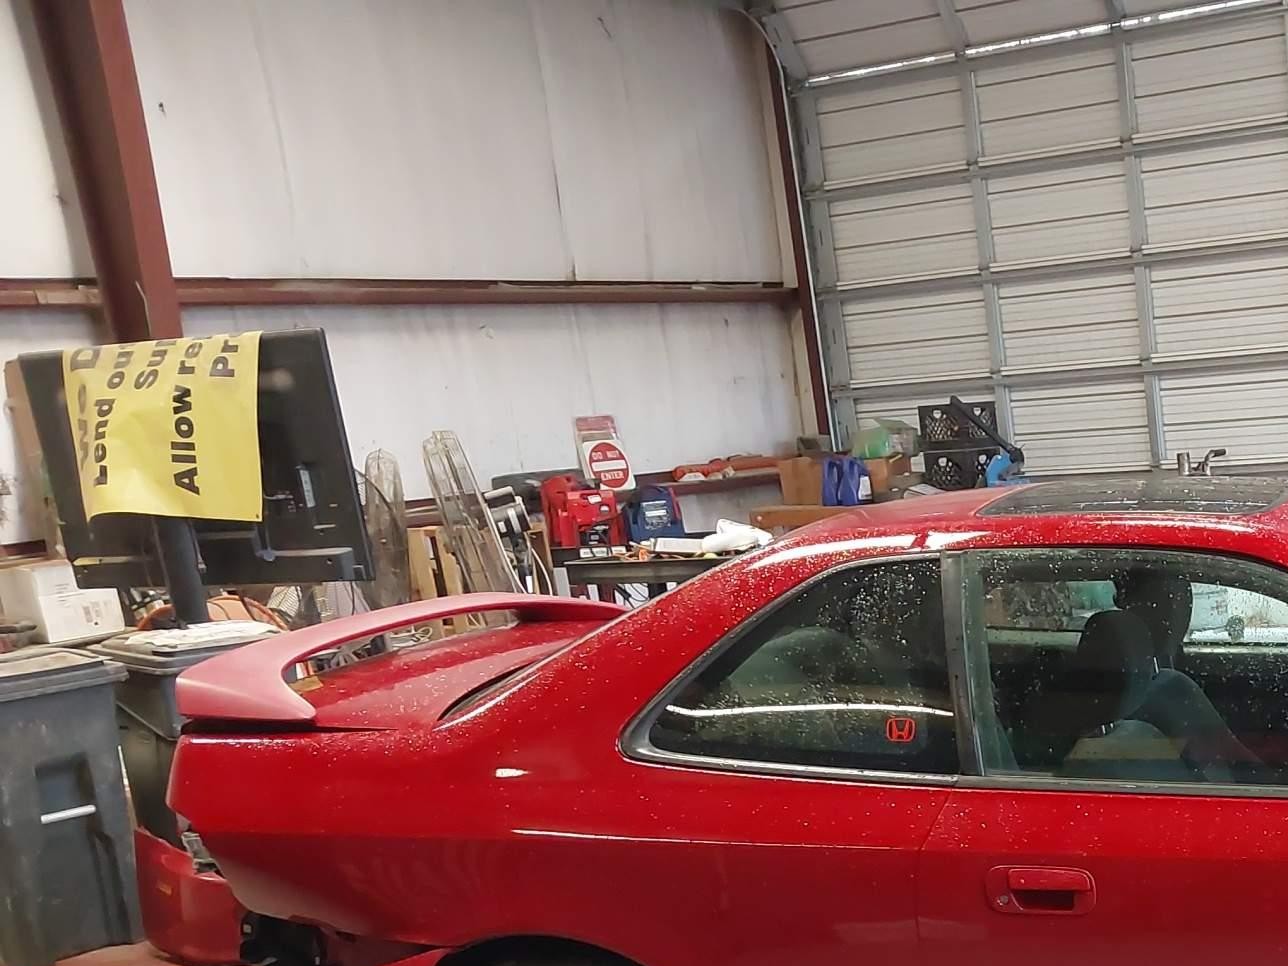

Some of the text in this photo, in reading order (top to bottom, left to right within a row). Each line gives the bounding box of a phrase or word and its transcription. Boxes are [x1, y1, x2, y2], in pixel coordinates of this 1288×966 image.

[209, 338, 239, 378] Pr
[171, 337, 208, 495] Allow re
[94, 398, 116, 487] Lend
[591, 450, 620, 460] DO NOT
[600, 470, 625, 481] ENTER
